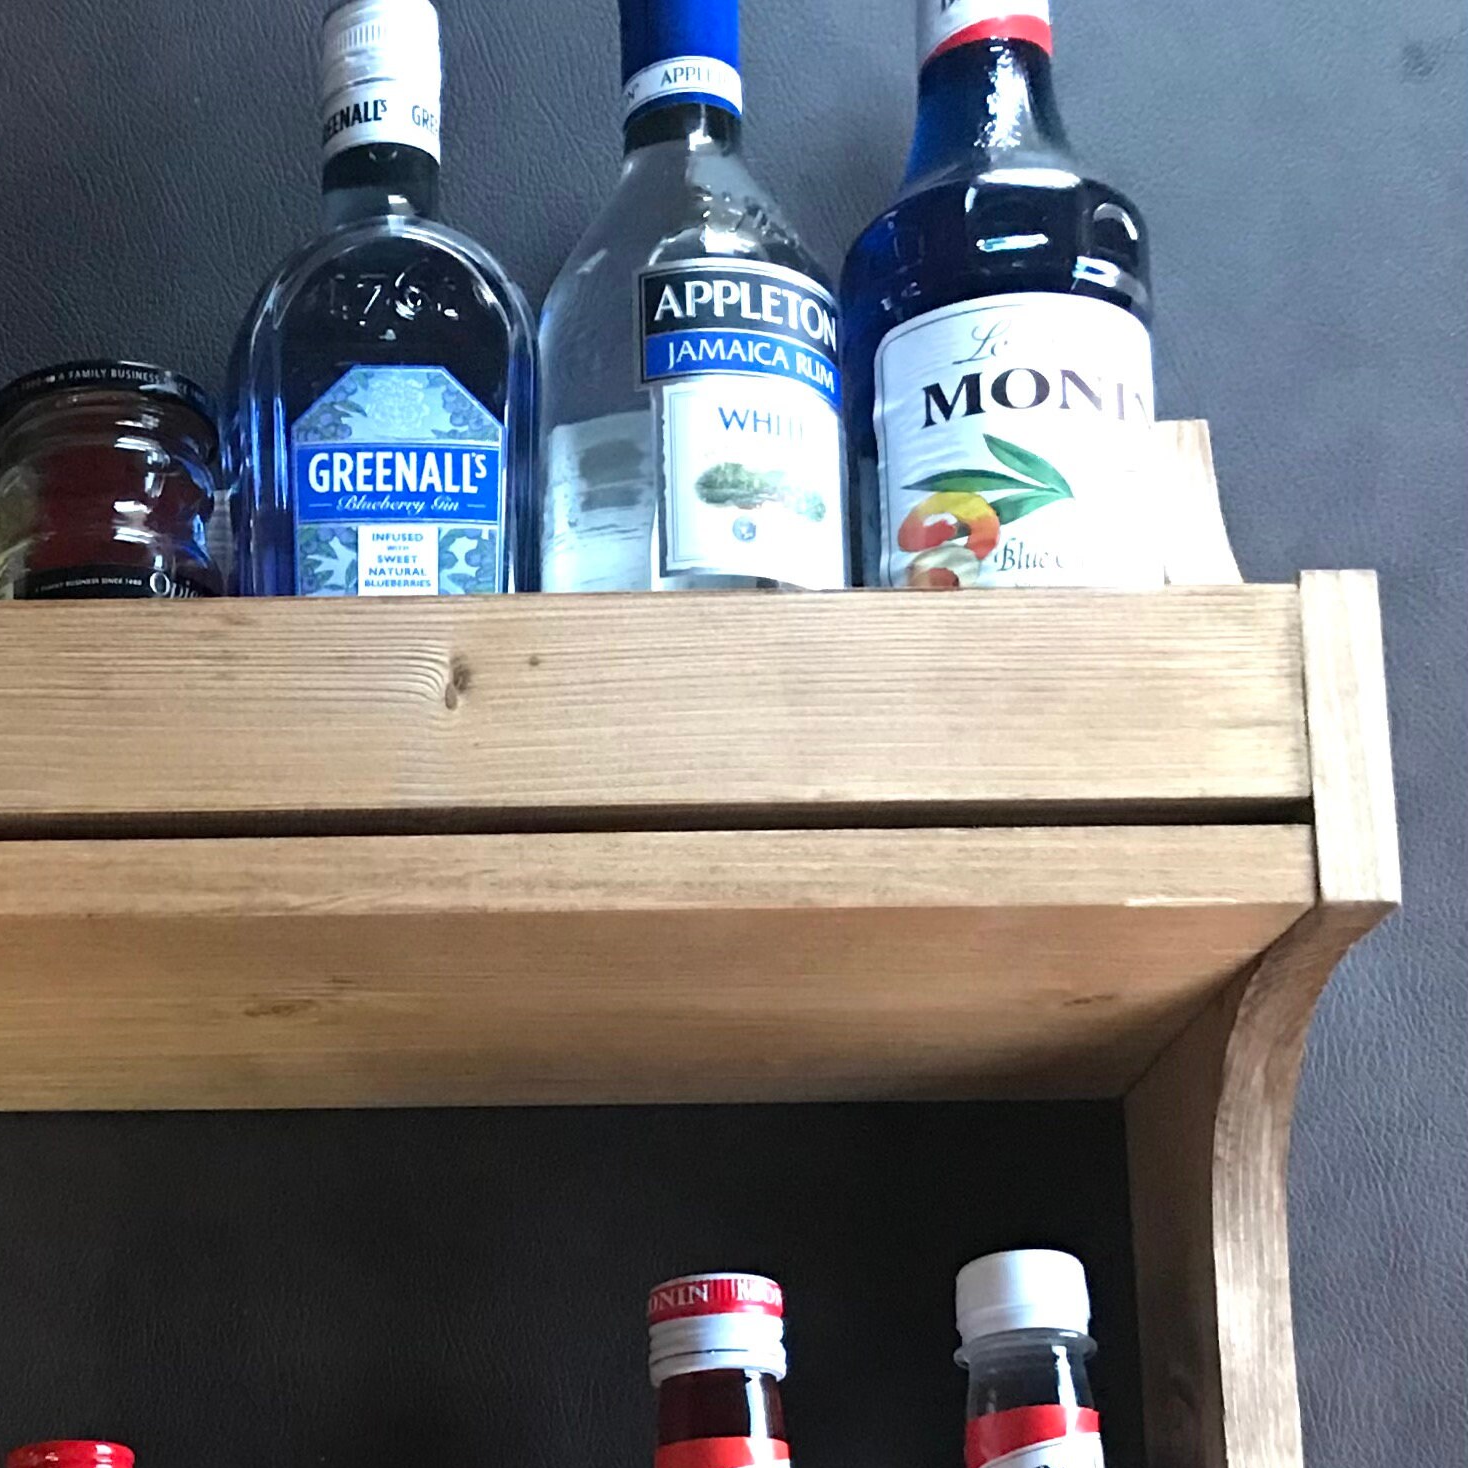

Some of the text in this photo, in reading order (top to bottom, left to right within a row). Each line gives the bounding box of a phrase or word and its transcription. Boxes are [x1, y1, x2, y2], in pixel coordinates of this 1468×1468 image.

[654, 279, 837, 352] APPLETON
[667, 337, 835, 394] JAMAICA RUM
[68, 368, 107, 379] FAMILY
[111, 368, 160, 384] BUSINESS
[308, 451, 488, 494] GREENALL'S
[336, 494, 460, 516] Blueberry Gin
[372, 532, 424, 542] INFUSED
[377, 554, 417, 564] SWEET
[368, 567, 427, 577] NATURAL
